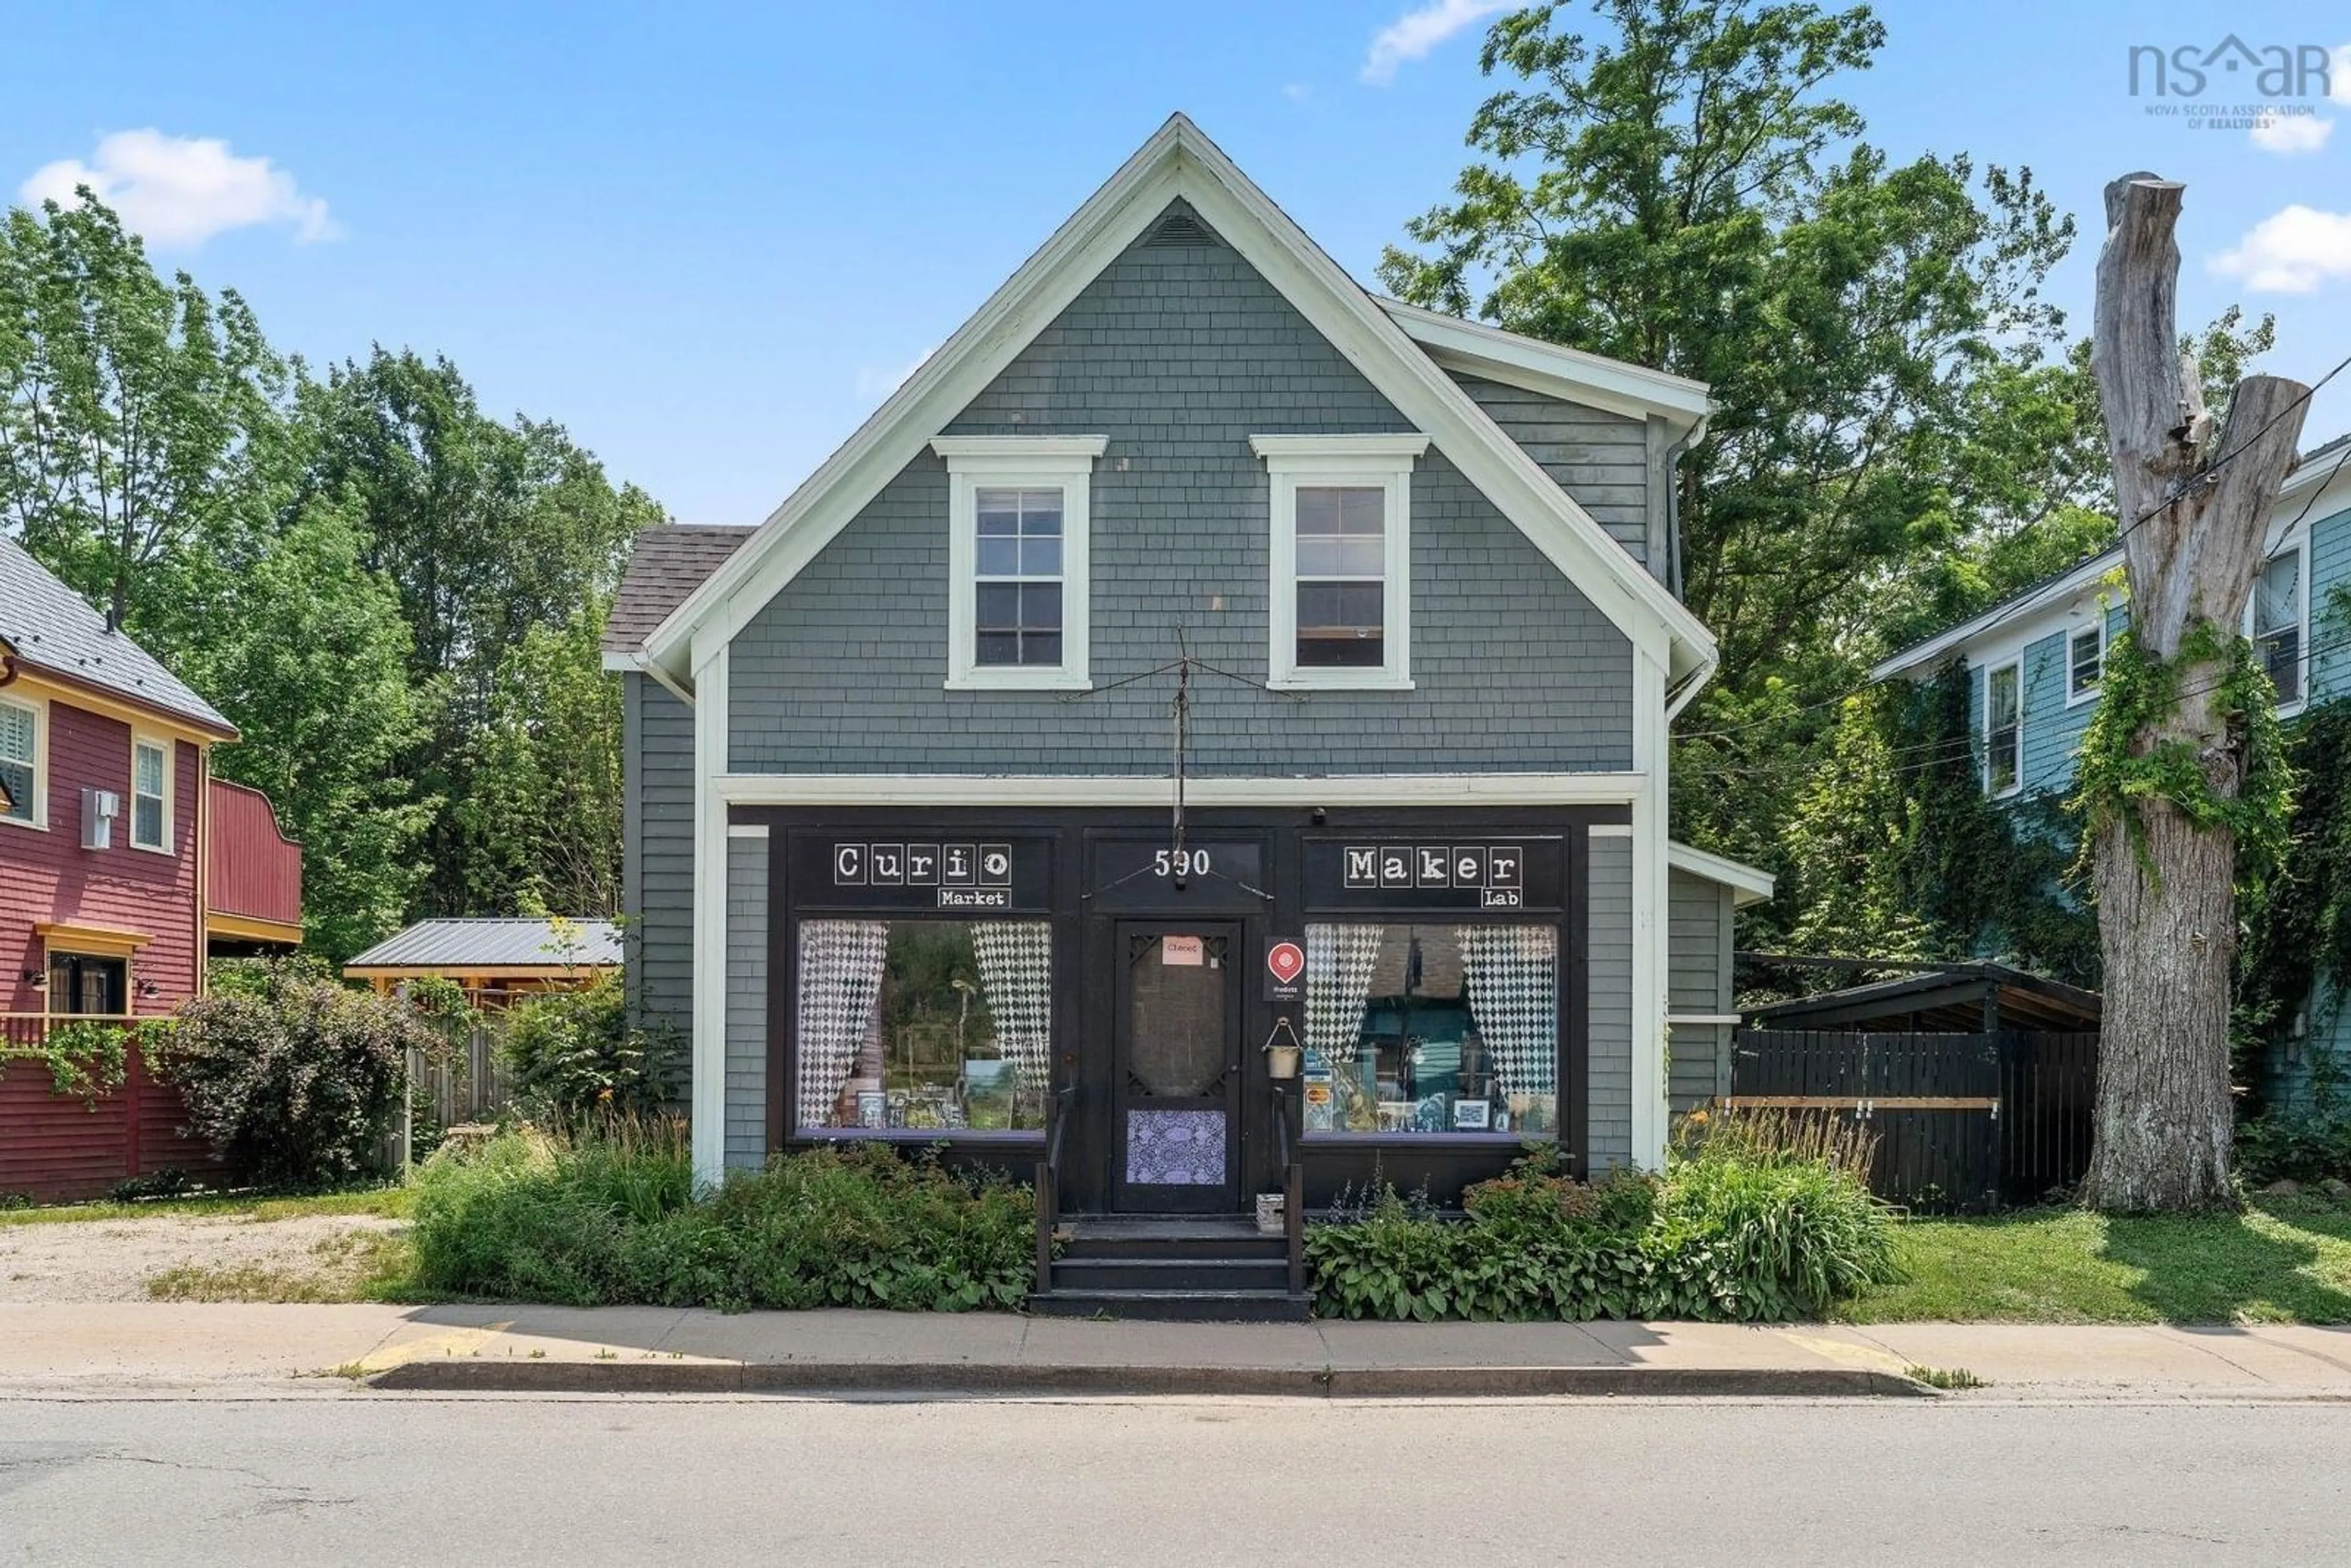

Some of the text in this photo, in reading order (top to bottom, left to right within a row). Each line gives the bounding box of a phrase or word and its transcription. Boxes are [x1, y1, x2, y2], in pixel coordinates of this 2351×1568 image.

[839, 848, 1008, 876] Curio
[1154, 849, 1209, 876] 590
[1348, 850, 1515, 879] Maker
[941, 891, 1005, 906] Market
[1485, 890, 1519, 906] Lab
